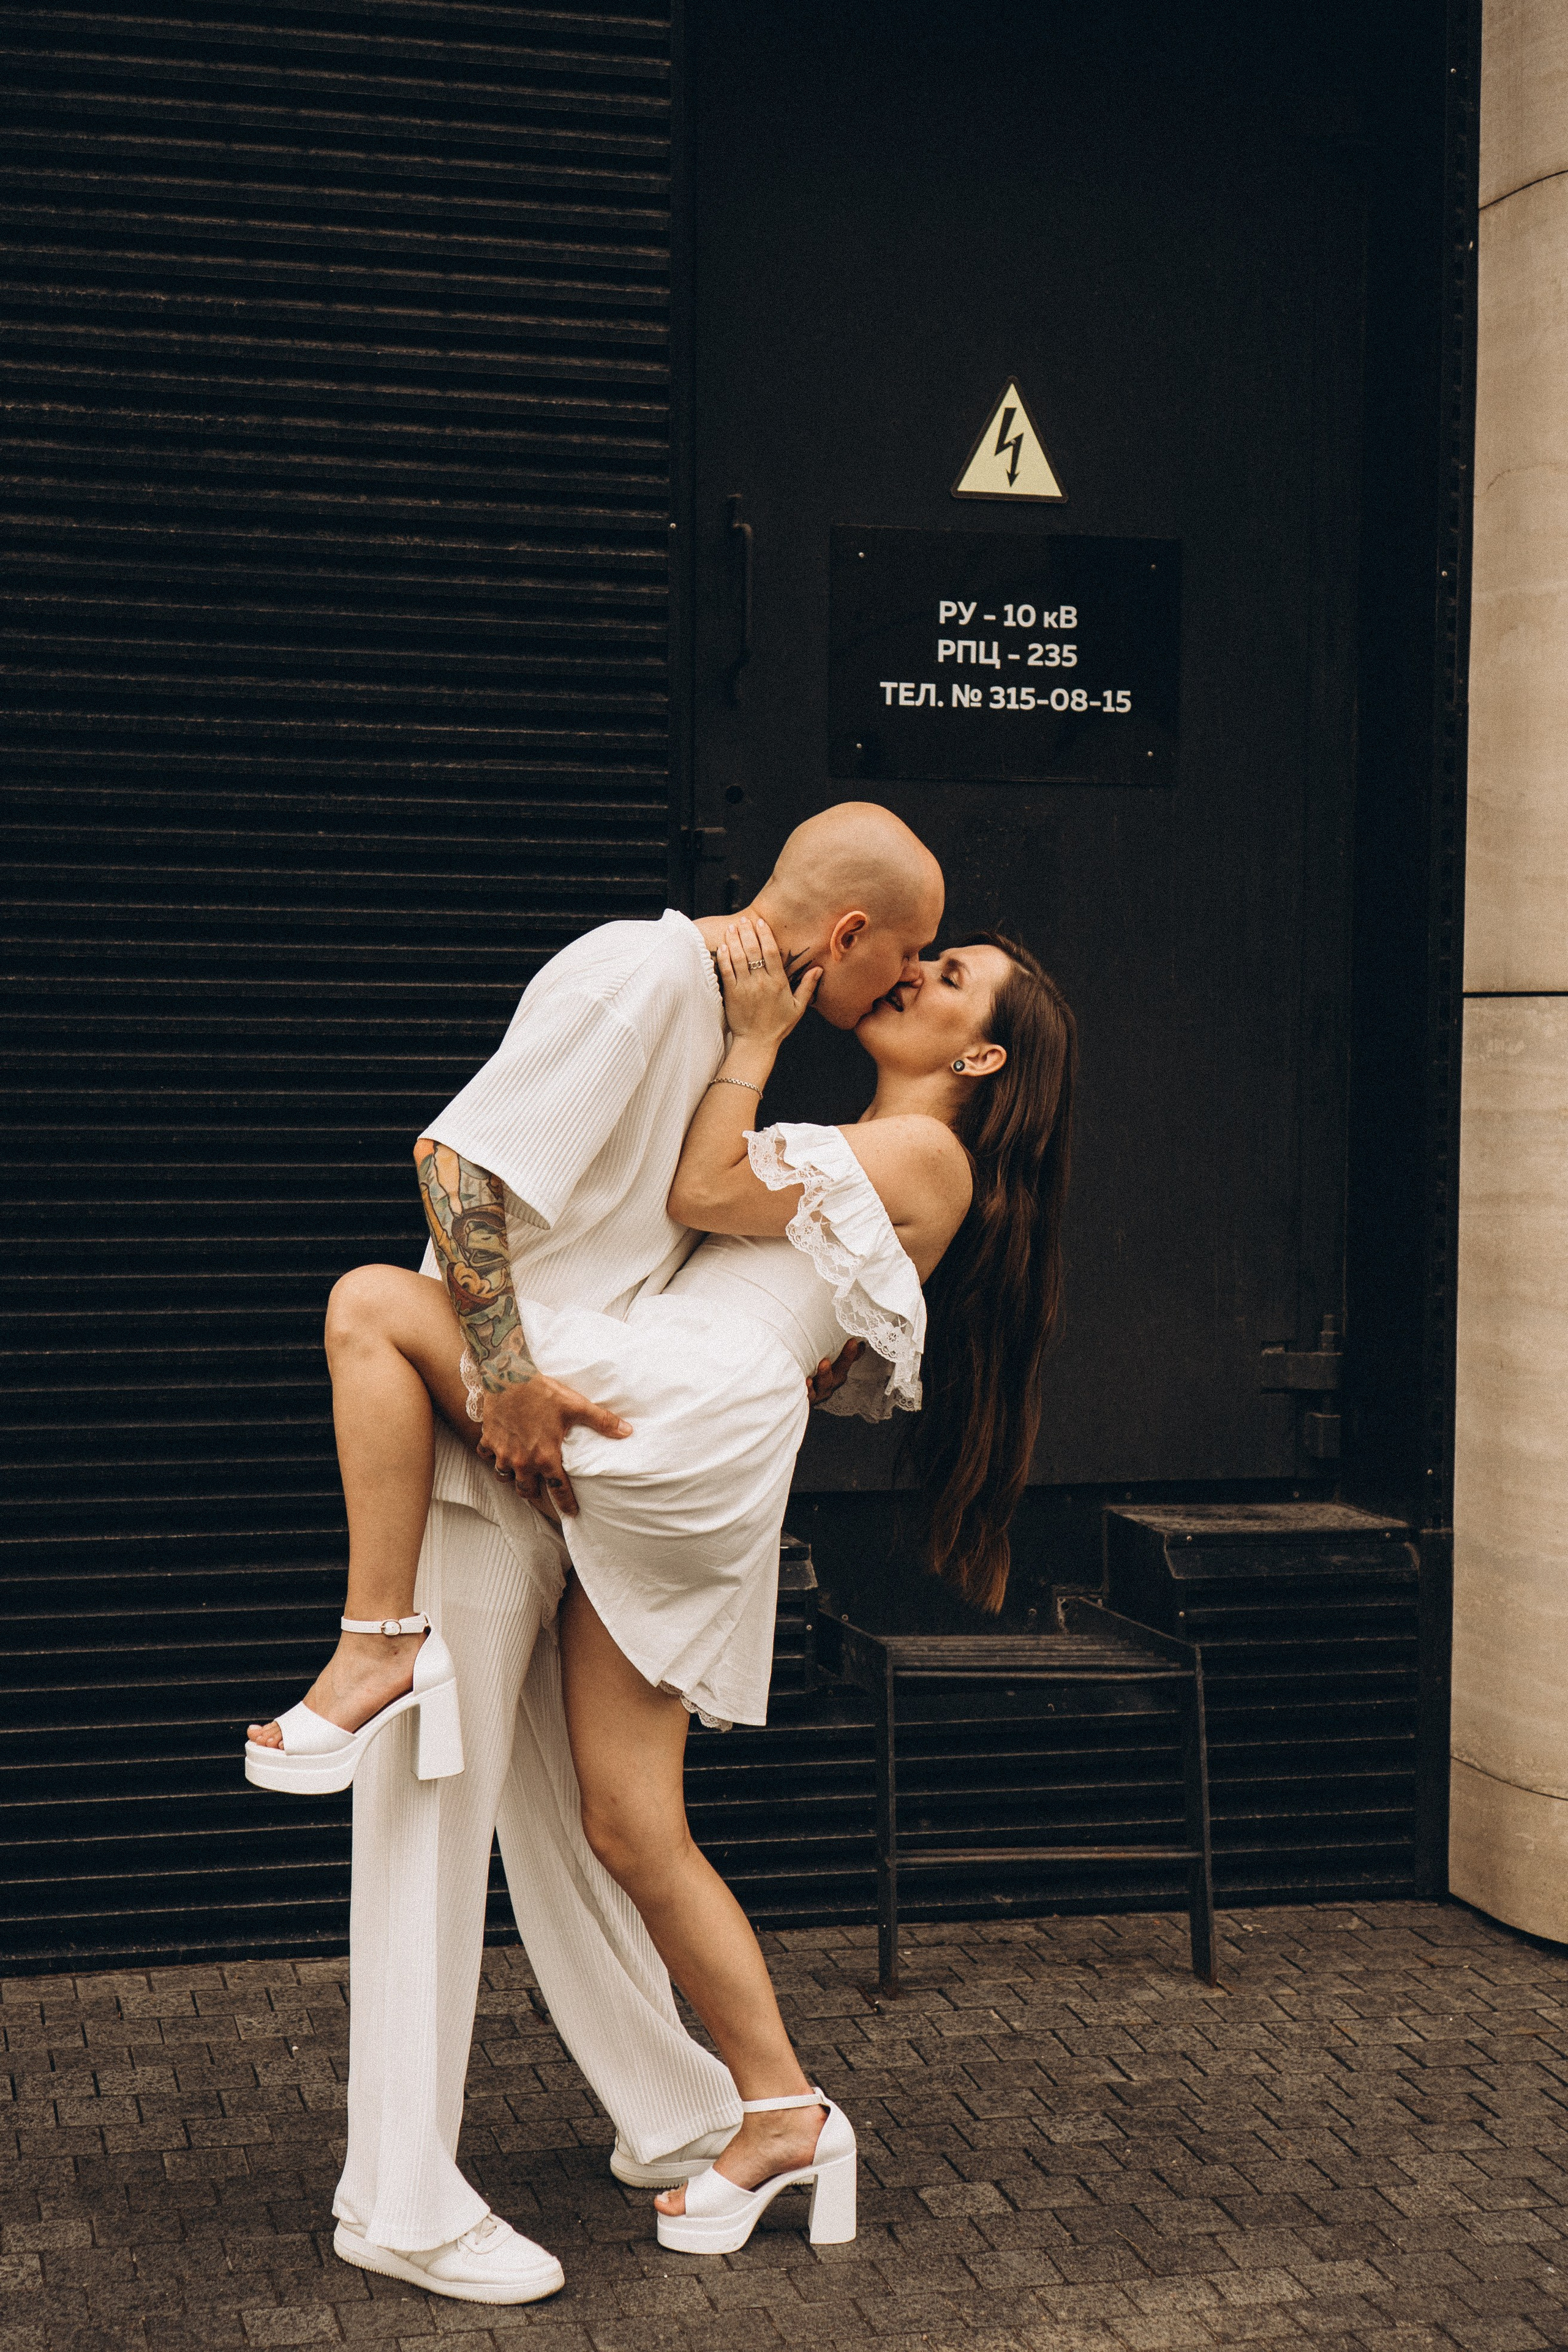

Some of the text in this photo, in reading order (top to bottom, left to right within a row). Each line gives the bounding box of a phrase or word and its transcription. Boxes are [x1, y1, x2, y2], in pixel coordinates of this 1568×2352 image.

[939, 600, 978, 625] РУ
[1003, 604, 1037, 628] 10
[1043, 605, 1078, 629] кВ
[938, 639, 1001, 669] РПЦ
[1027, 643, 1078, 668] 235
[880, 681, 1132, 714] ТЕЛ. № 315-08-15
